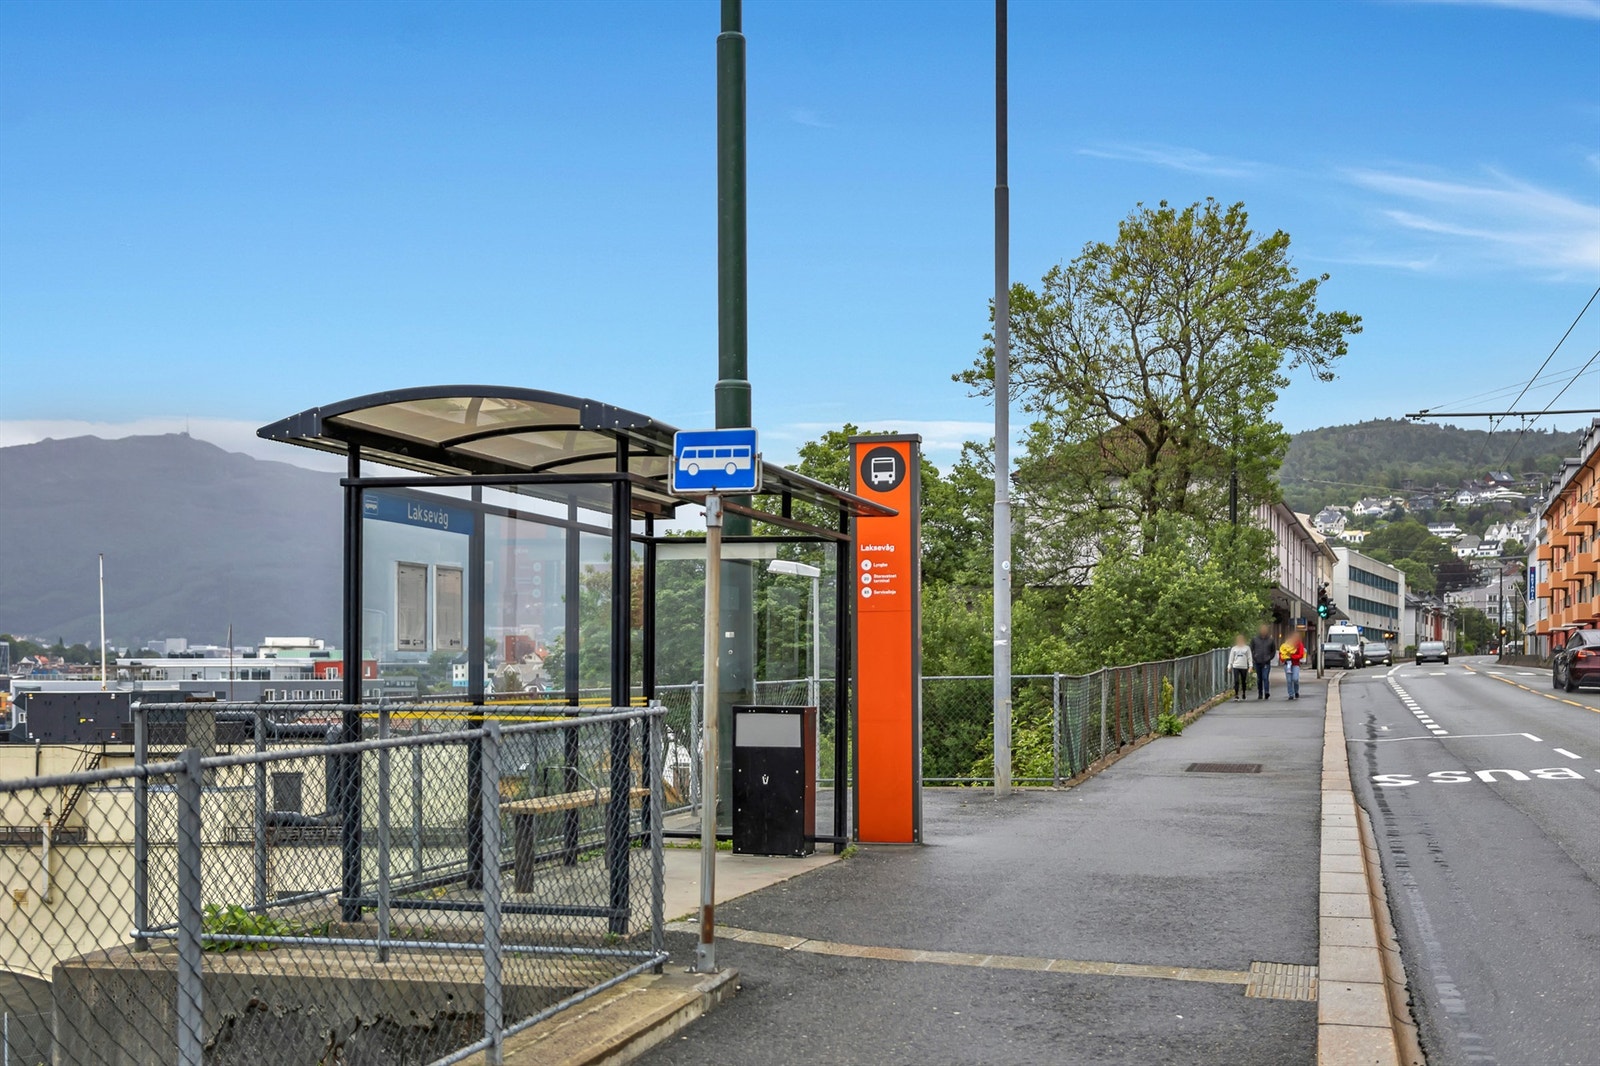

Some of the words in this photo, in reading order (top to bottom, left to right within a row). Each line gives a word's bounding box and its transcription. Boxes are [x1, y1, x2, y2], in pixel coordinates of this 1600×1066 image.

[407, 502, 449, 529] Laksevåg
[860, 544, 895, 552] Laksevåg
[1372, 767, 1585, 787] BUSS
